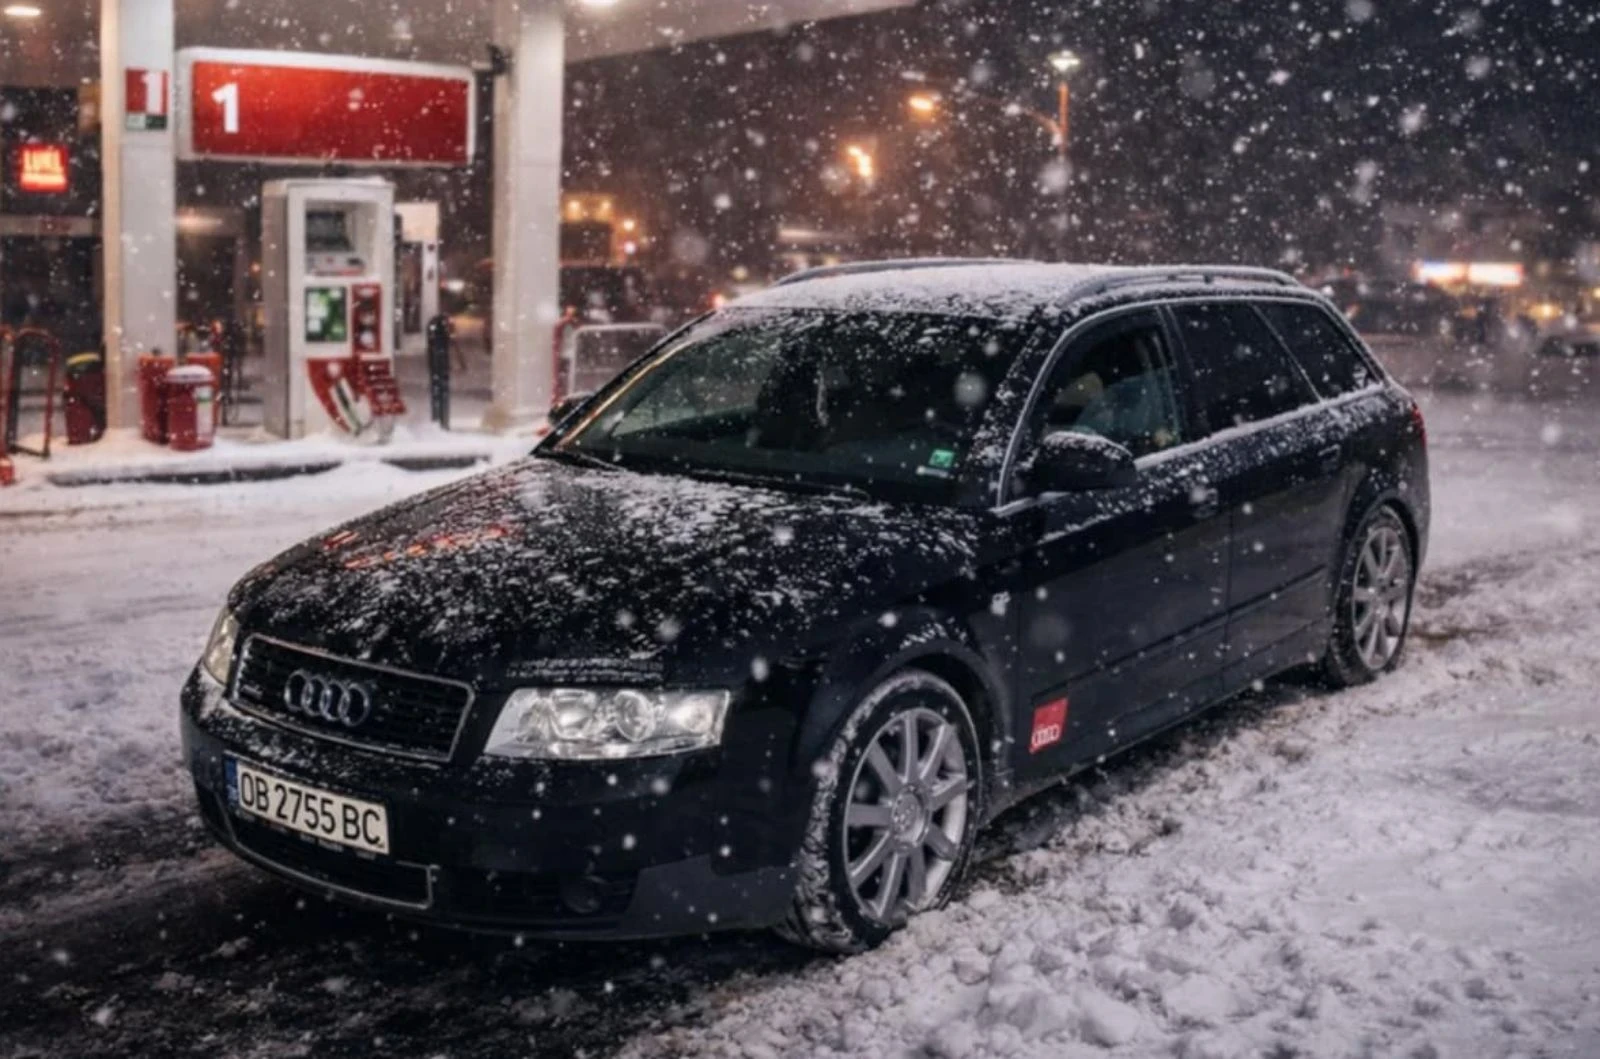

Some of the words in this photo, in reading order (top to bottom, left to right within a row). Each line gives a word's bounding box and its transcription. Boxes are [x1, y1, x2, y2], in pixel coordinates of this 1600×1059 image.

[141, 71, 162, 115] 1
[211, 82, 240, 134] 1
[240, 771, 270, 813] OB
[274, 784, 336, 835] 2755
[342, 803, 381, 846] BC
